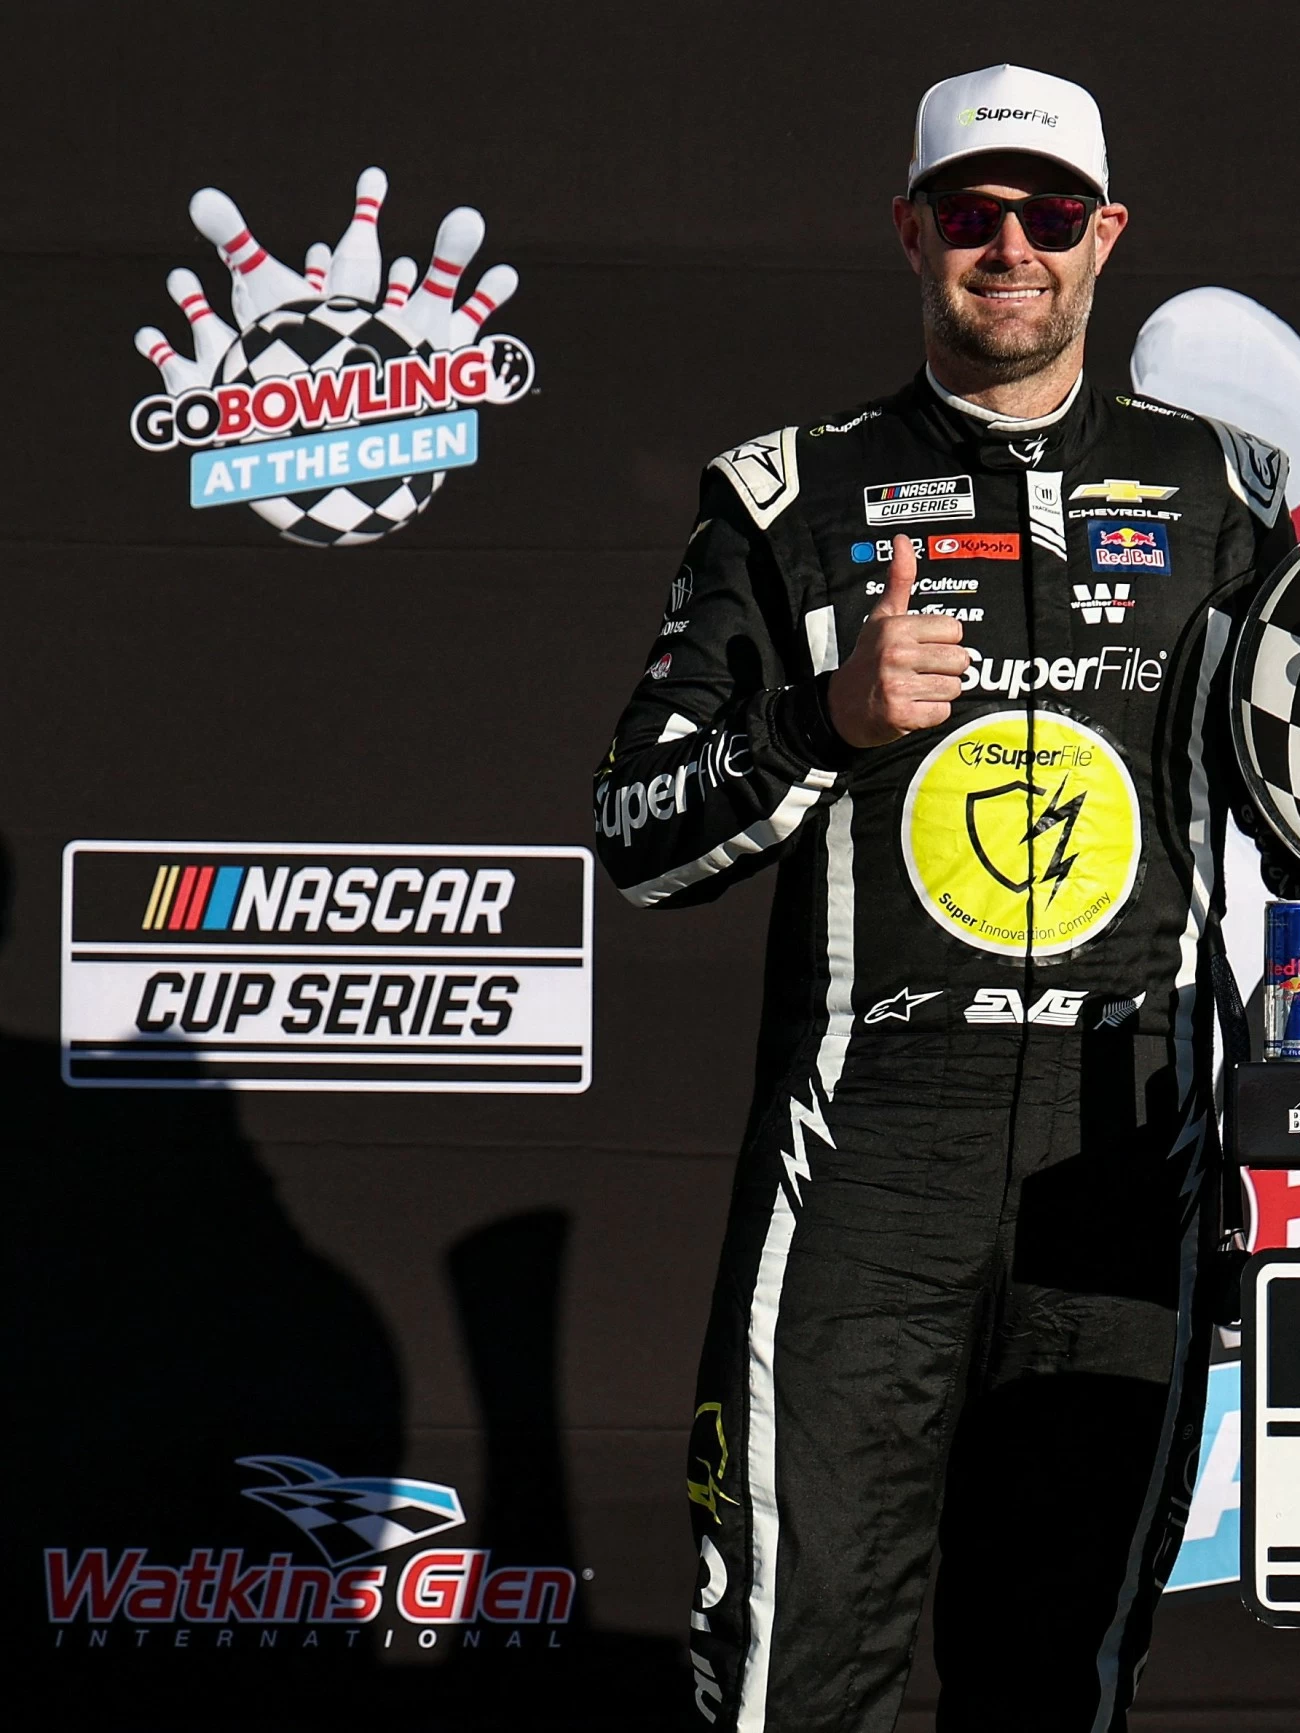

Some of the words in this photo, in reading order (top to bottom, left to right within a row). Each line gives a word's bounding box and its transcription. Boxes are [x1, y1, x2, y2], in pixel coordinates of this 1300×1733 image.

[976, 107, 1057, 127] SuperFile
[204, 456, 261, 495] AT
[266, 442, 350, 480] THE
[358, 422, 467, 468] GLEN
[899, 481, 956, 497] NASCAR
[881, 503, 909, 515] CUP
[911, 499, 958, 512] SERIES
[1068, 508, 1182, 521] CHEVROLET
[961, 540, 1013, 552] Kubota
[1097, 549, 1130, 565] Red
[1132, 549, 1165, 567] Bull
[961, 646, 1164, 699] SuperFile
[985, 744, 1093, 769] SuperFile
[232, 866, 515, 934] NASCAR
[939, 892, 977, 927] Super
[1058, 892, 1111, 935] Company
[135, 971, 275, 1034] CUP
[281, 974, 519, 1036] SERIES
[43, 1548, 387, 1624] Watkins
[397, 1548, 577, 1624] Glen
[55, 1629, 562, 1648] INTERNATIONAL
